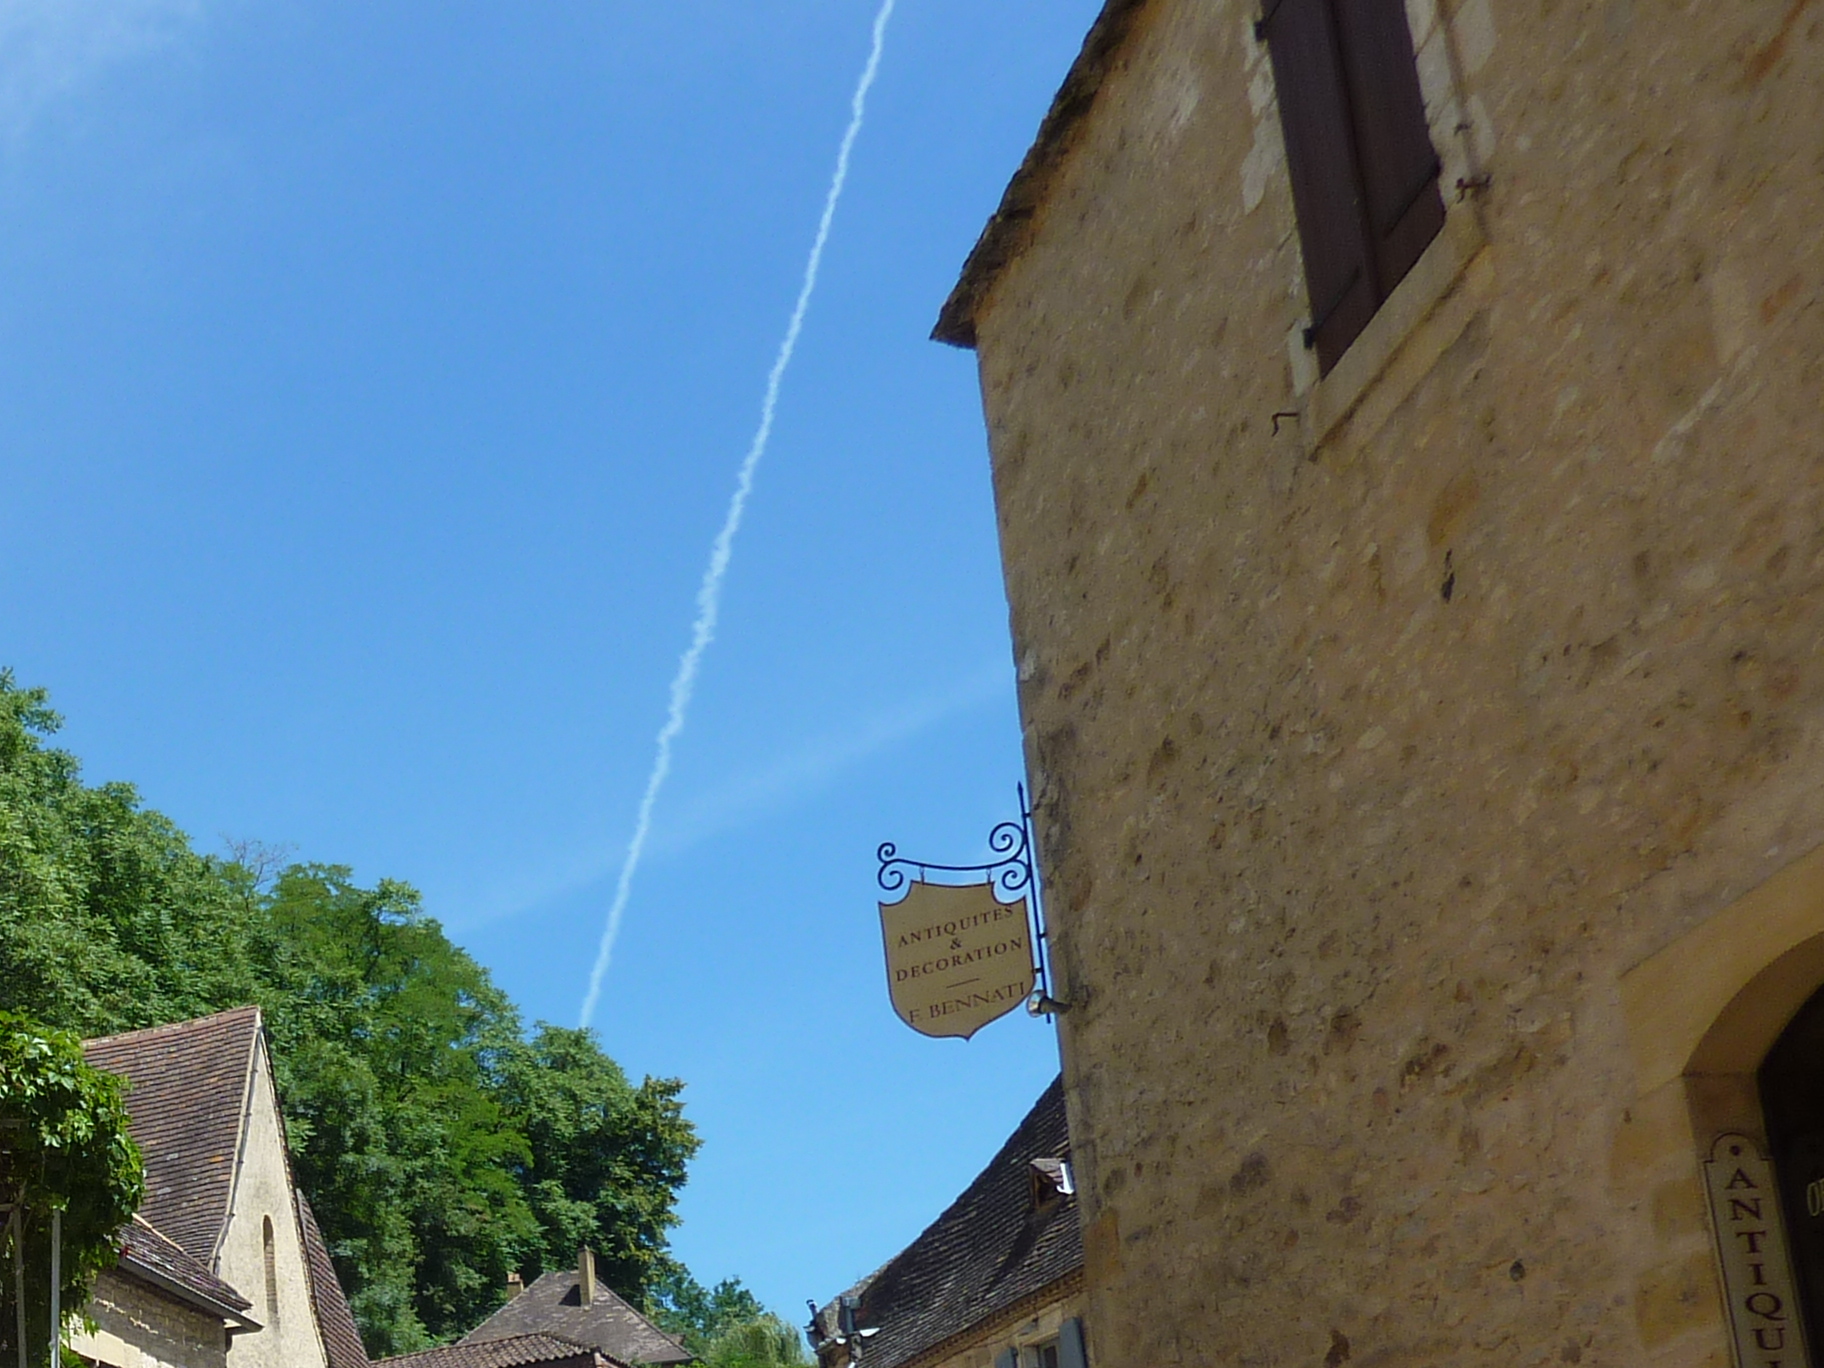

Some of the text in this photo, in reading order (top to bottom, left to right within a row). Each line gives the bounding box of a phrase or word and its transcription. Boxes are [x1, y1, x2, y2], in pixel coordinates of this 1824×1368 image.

[898, 906, 1014, 949] ANTIQUITES
[949, 937, 963, 951] &
[896, 937, 1023, 982] DECORATION
[930, 981, 1025, 1019] BENNATI
